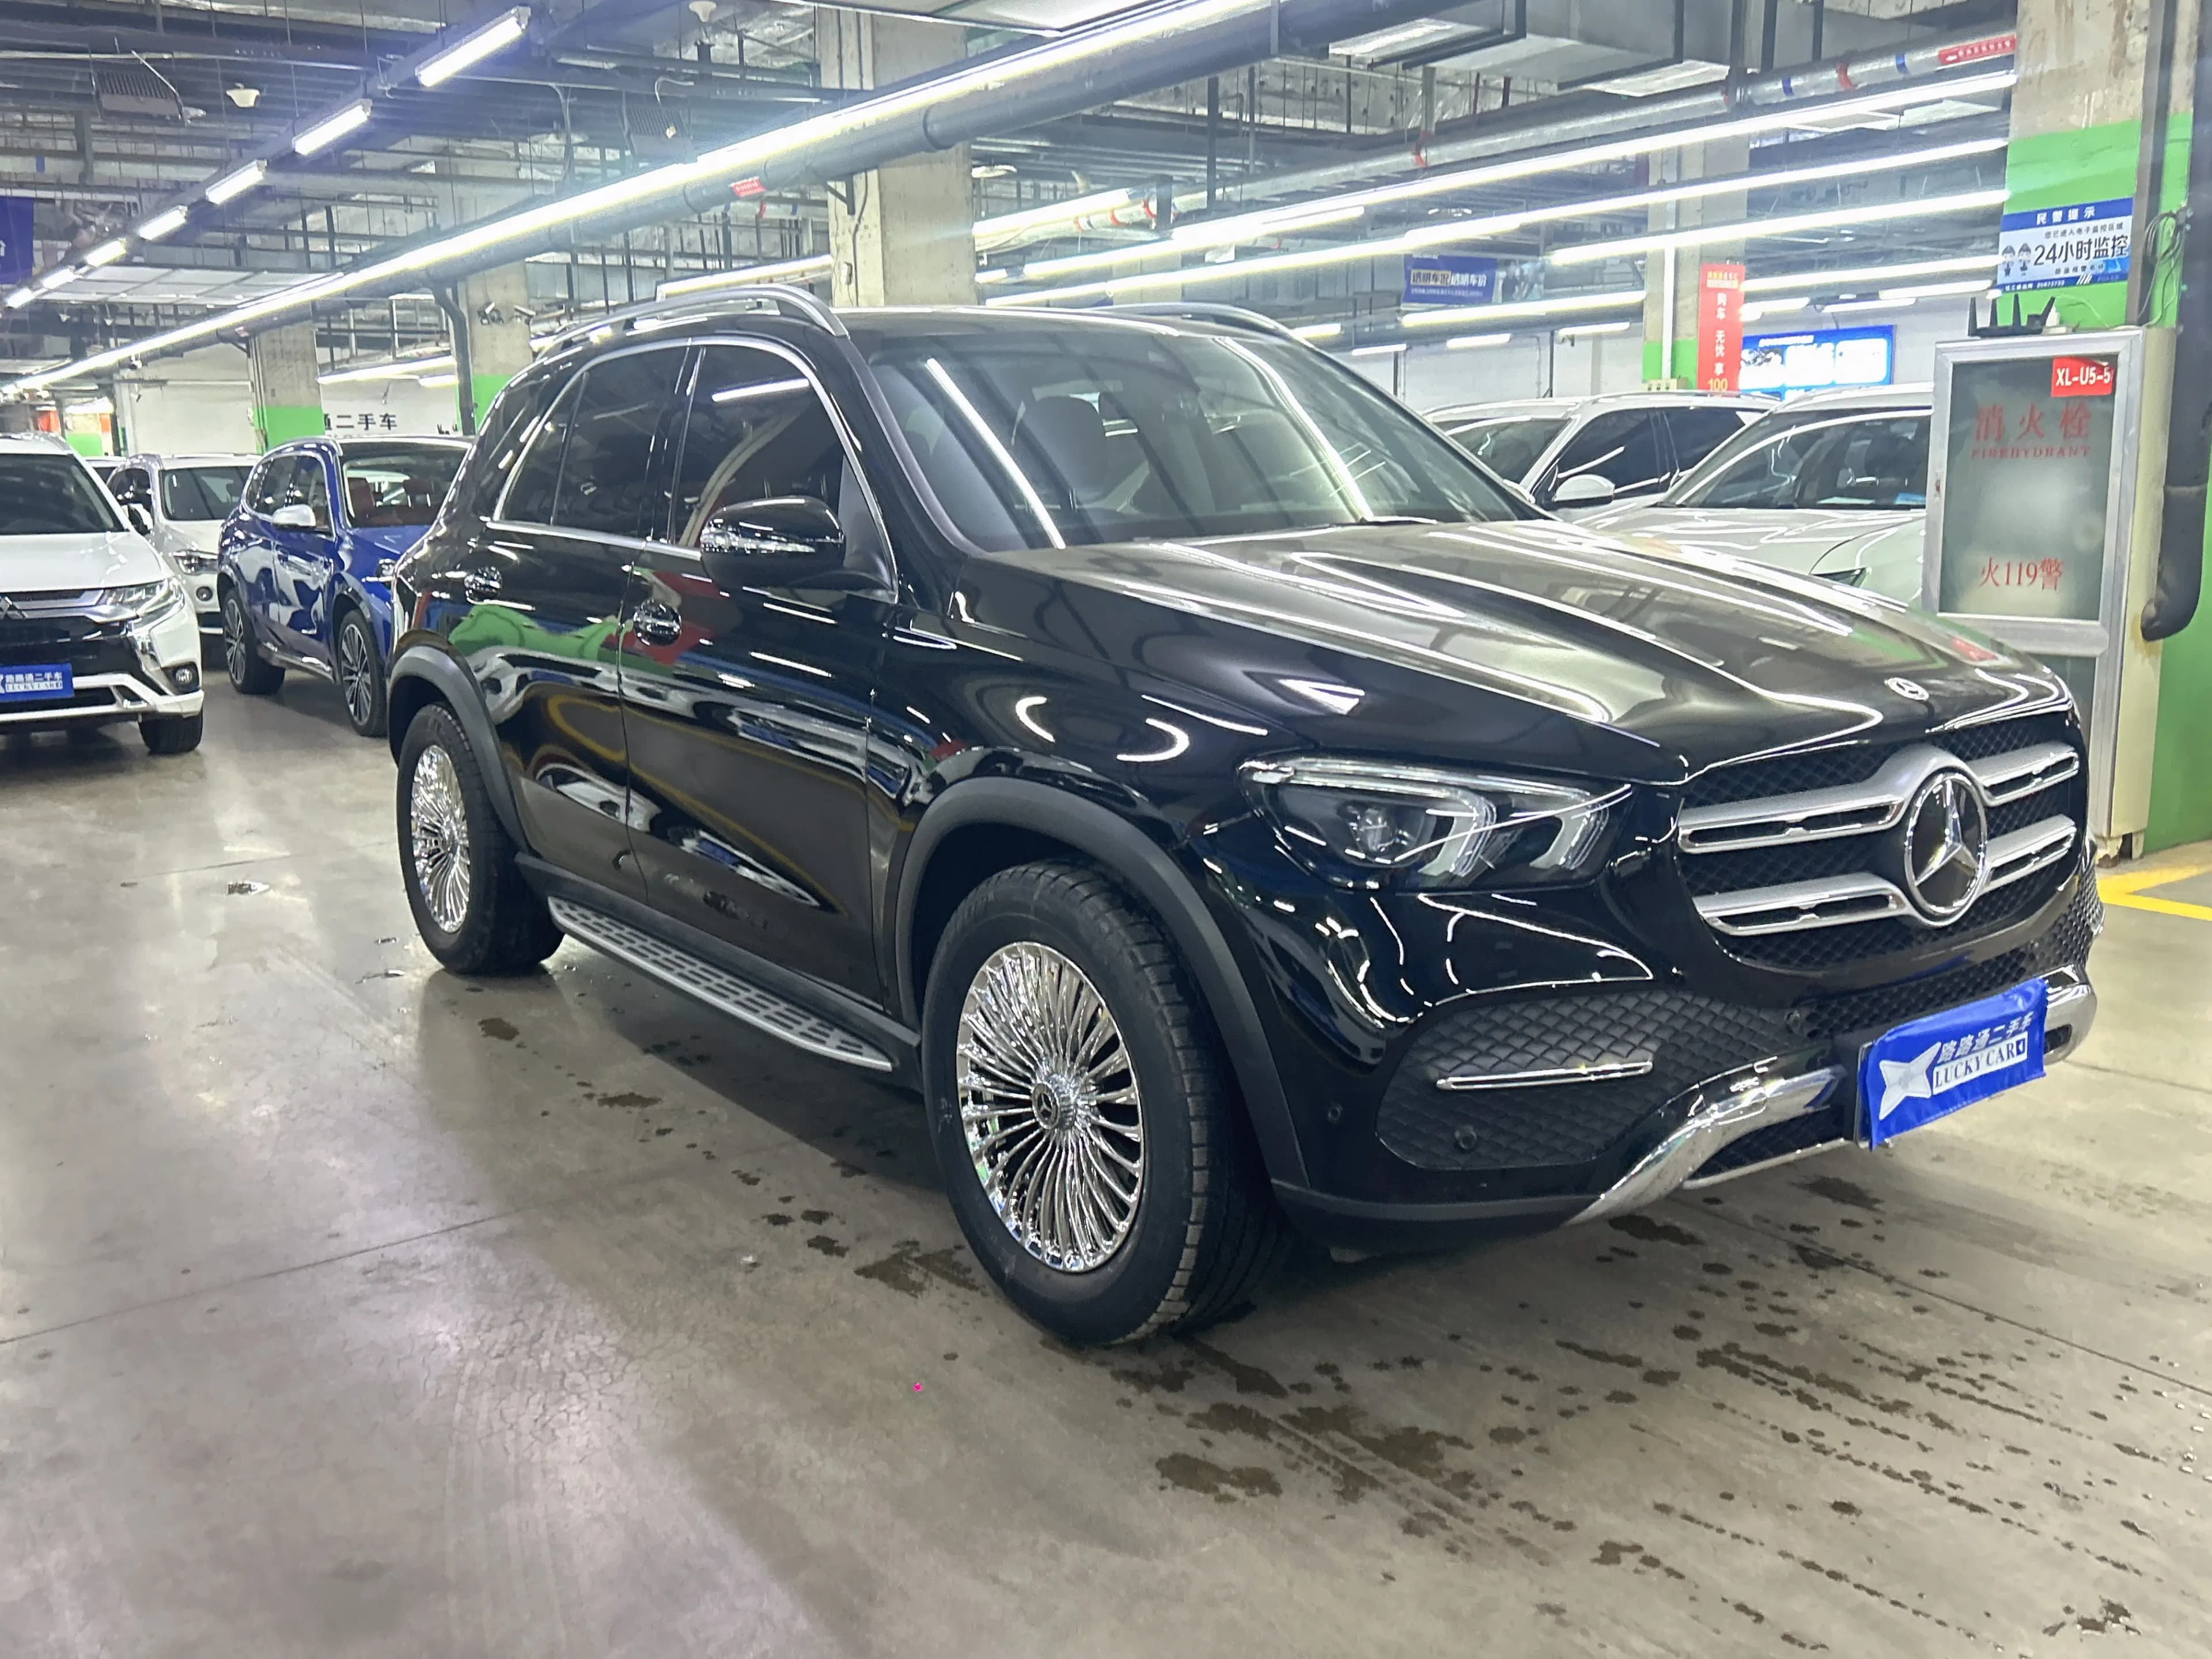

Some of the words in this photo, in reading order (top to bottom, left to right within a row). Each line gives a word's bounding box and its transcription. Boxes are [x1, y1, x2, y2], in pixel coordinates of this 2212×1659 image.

[2036, 206, 2095, 225] 民警提示
[2033, 234, 2128, 267] 24小时监控
[1708, 378, 1729, 391] 100
[2055, 365, 2111, 387] XL-U5-5
[1975, 401, 2092, 442] 消火栓
[1979, 555, 2064, 591] 火119警
[1935, 1055, 1983, 1088] LUCKY
[1987, 1042, 2015, 1066] CAR
